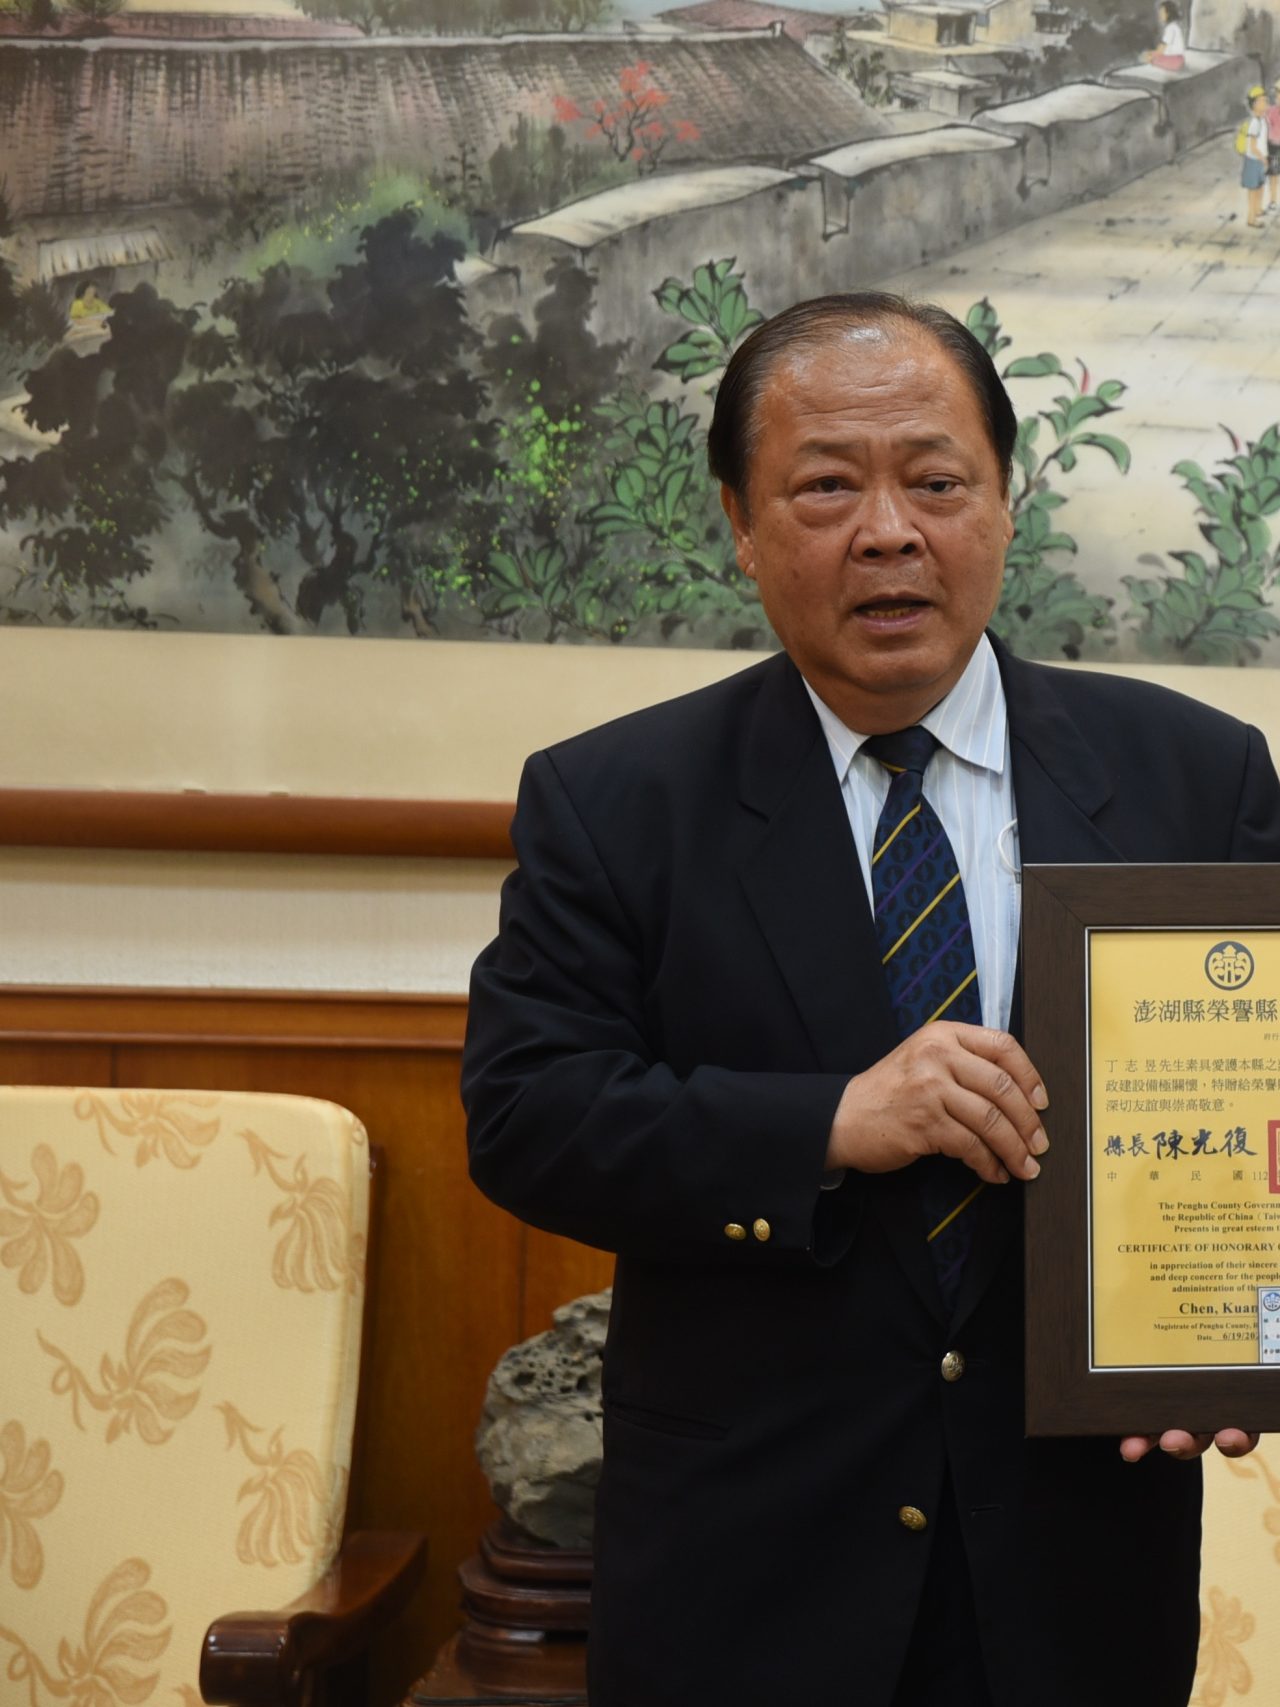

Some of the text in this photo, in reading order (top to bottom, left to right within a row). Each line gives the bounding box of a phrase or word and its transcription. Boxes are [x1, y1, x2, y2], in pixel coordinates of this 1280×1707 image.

[1159, 1202, 1174, 1210] The
[1177, 1201, 1208, 1211] Penghu
[1211, 1201, 1241, 1210] County
[1162, 1214, 1175, 1222] the
[1178, 1213, 1216, 1223] Republic
[1218, 1213, 1226, 1221] of
[1228, 1213, 1253, 1221] China
[1174, 1225, 1210, 1233] Presents
[1222, 1225, 1244, 1234] great
[1118, 1243, 1192, 1253] CERTIFICATE
[1194, 1243, 1210, 1252] OF
[1212, 1242, 1275, 1252] HONORARY
[1150, 1262, 1158, 1270] in
[1161, 1262, 1213, 1271] appreciation
[1215, 1261, 1224, 1269] of
[1226, 1261, 1245, 1269] their
[1248, 1261, 1278, 1269] sincere
[1168, 1273, 1188, 1282] deep
[1172, 1284, 1258, 1293] administration of th
[1179, 1302, 1219, 1315] Chen,
[1153, 1323, 1189, 1331] Magistrate
[1199, 1322, 1224, 1330] Penghu
